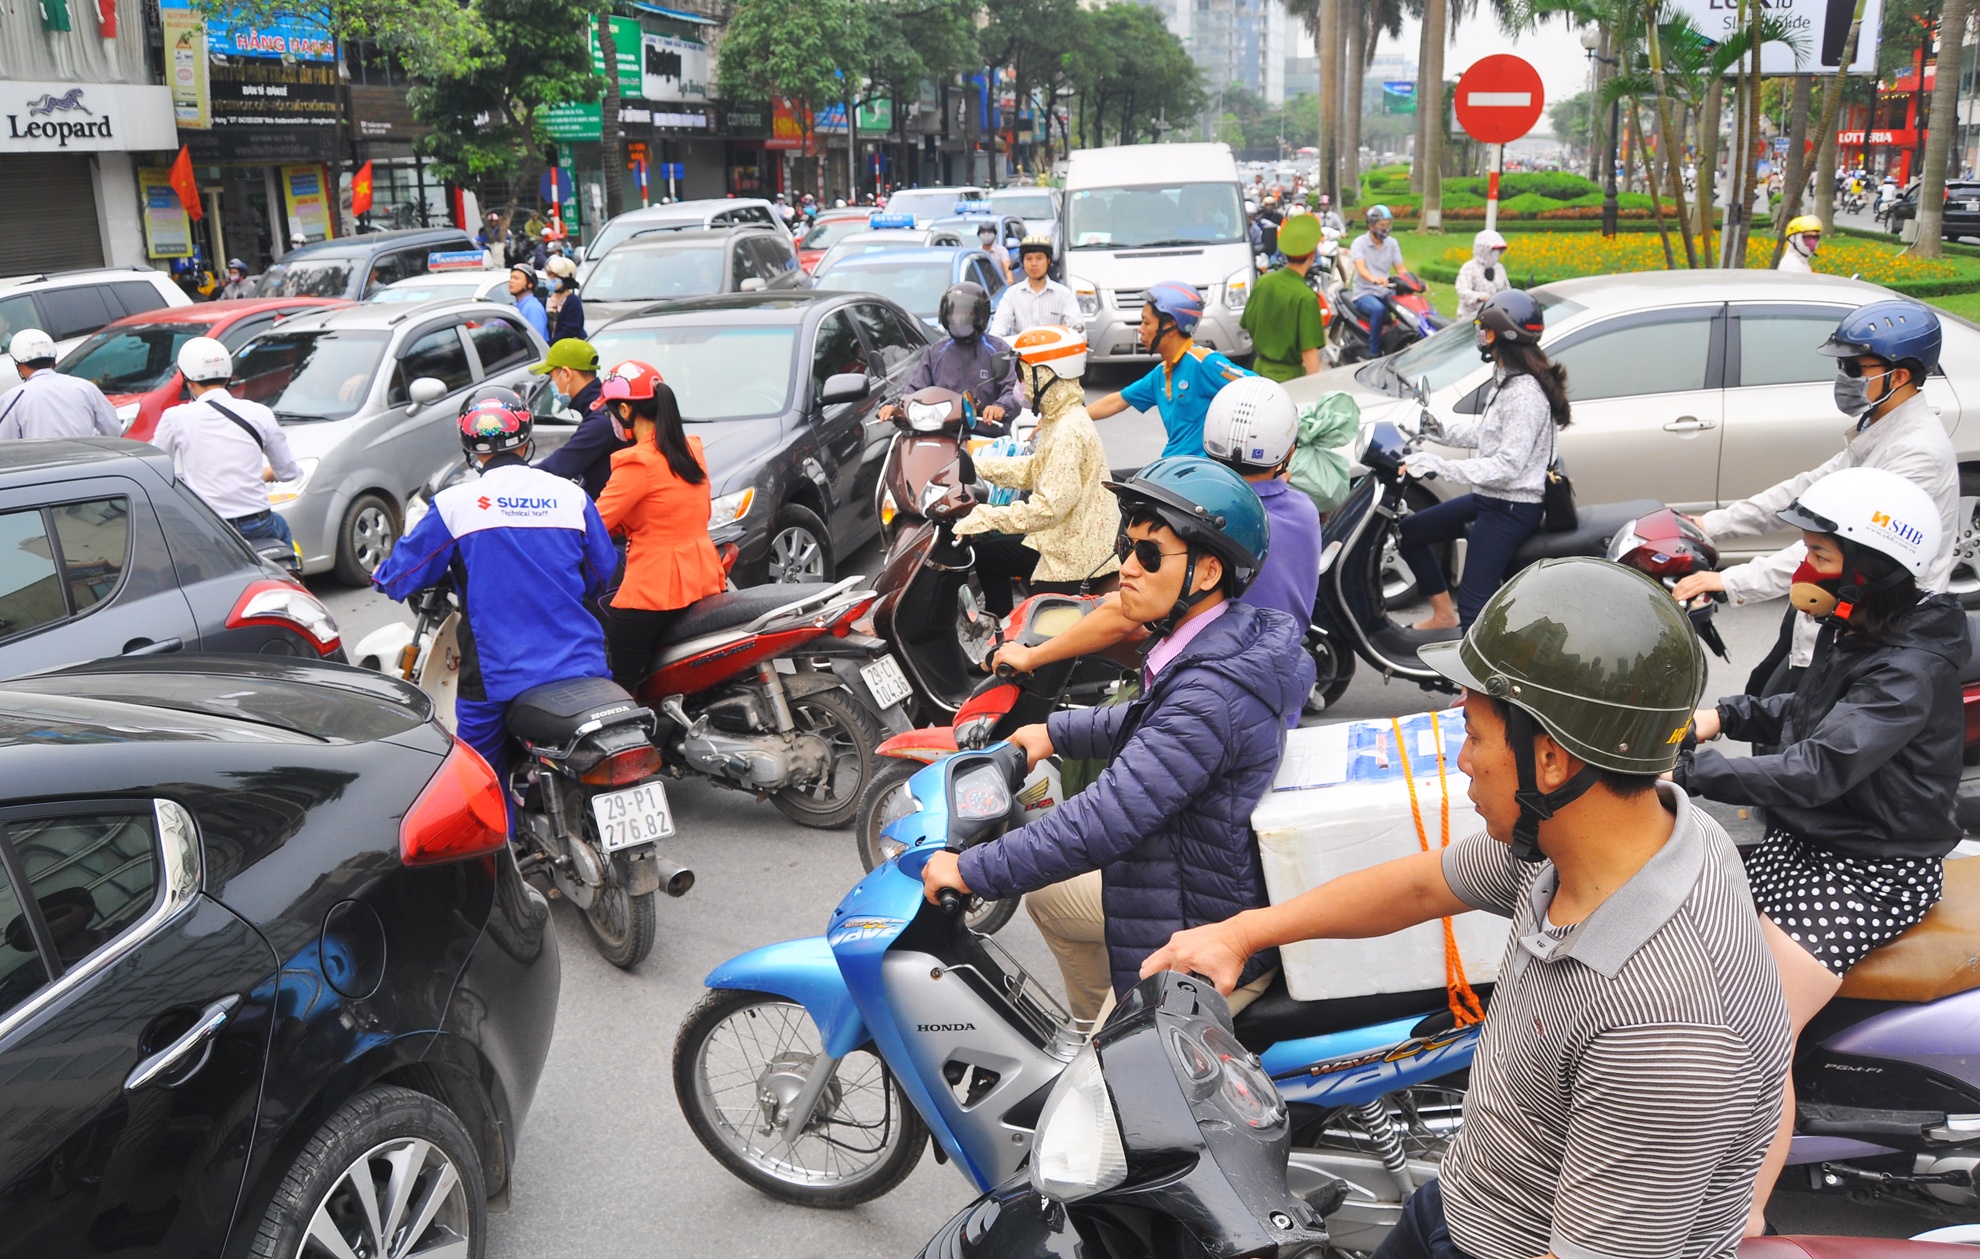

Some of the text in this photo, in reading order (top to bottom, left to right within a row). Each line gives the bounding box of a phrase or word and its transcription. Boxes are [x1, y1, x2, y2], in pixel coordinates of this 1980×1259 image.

[6, 114, 113, 147] Leopard
[1838, 131, 1893, 144] LOTTRIA
[496, 497, 558, 509] SUZUKI
[501, 509, 531, 517] Technical
[1888, 519, 1924, 546] SHB
[876, 676, 909, 705] 104.36
[590, 705, 631, 721] HONDA
[604, 787, 656, 821] 29-P1
[605, 811, 670, 847] 276.82
[917, 1022, 977, 1032] HONDA
[1824, 1063, 1883, 1074] PGM-FI
